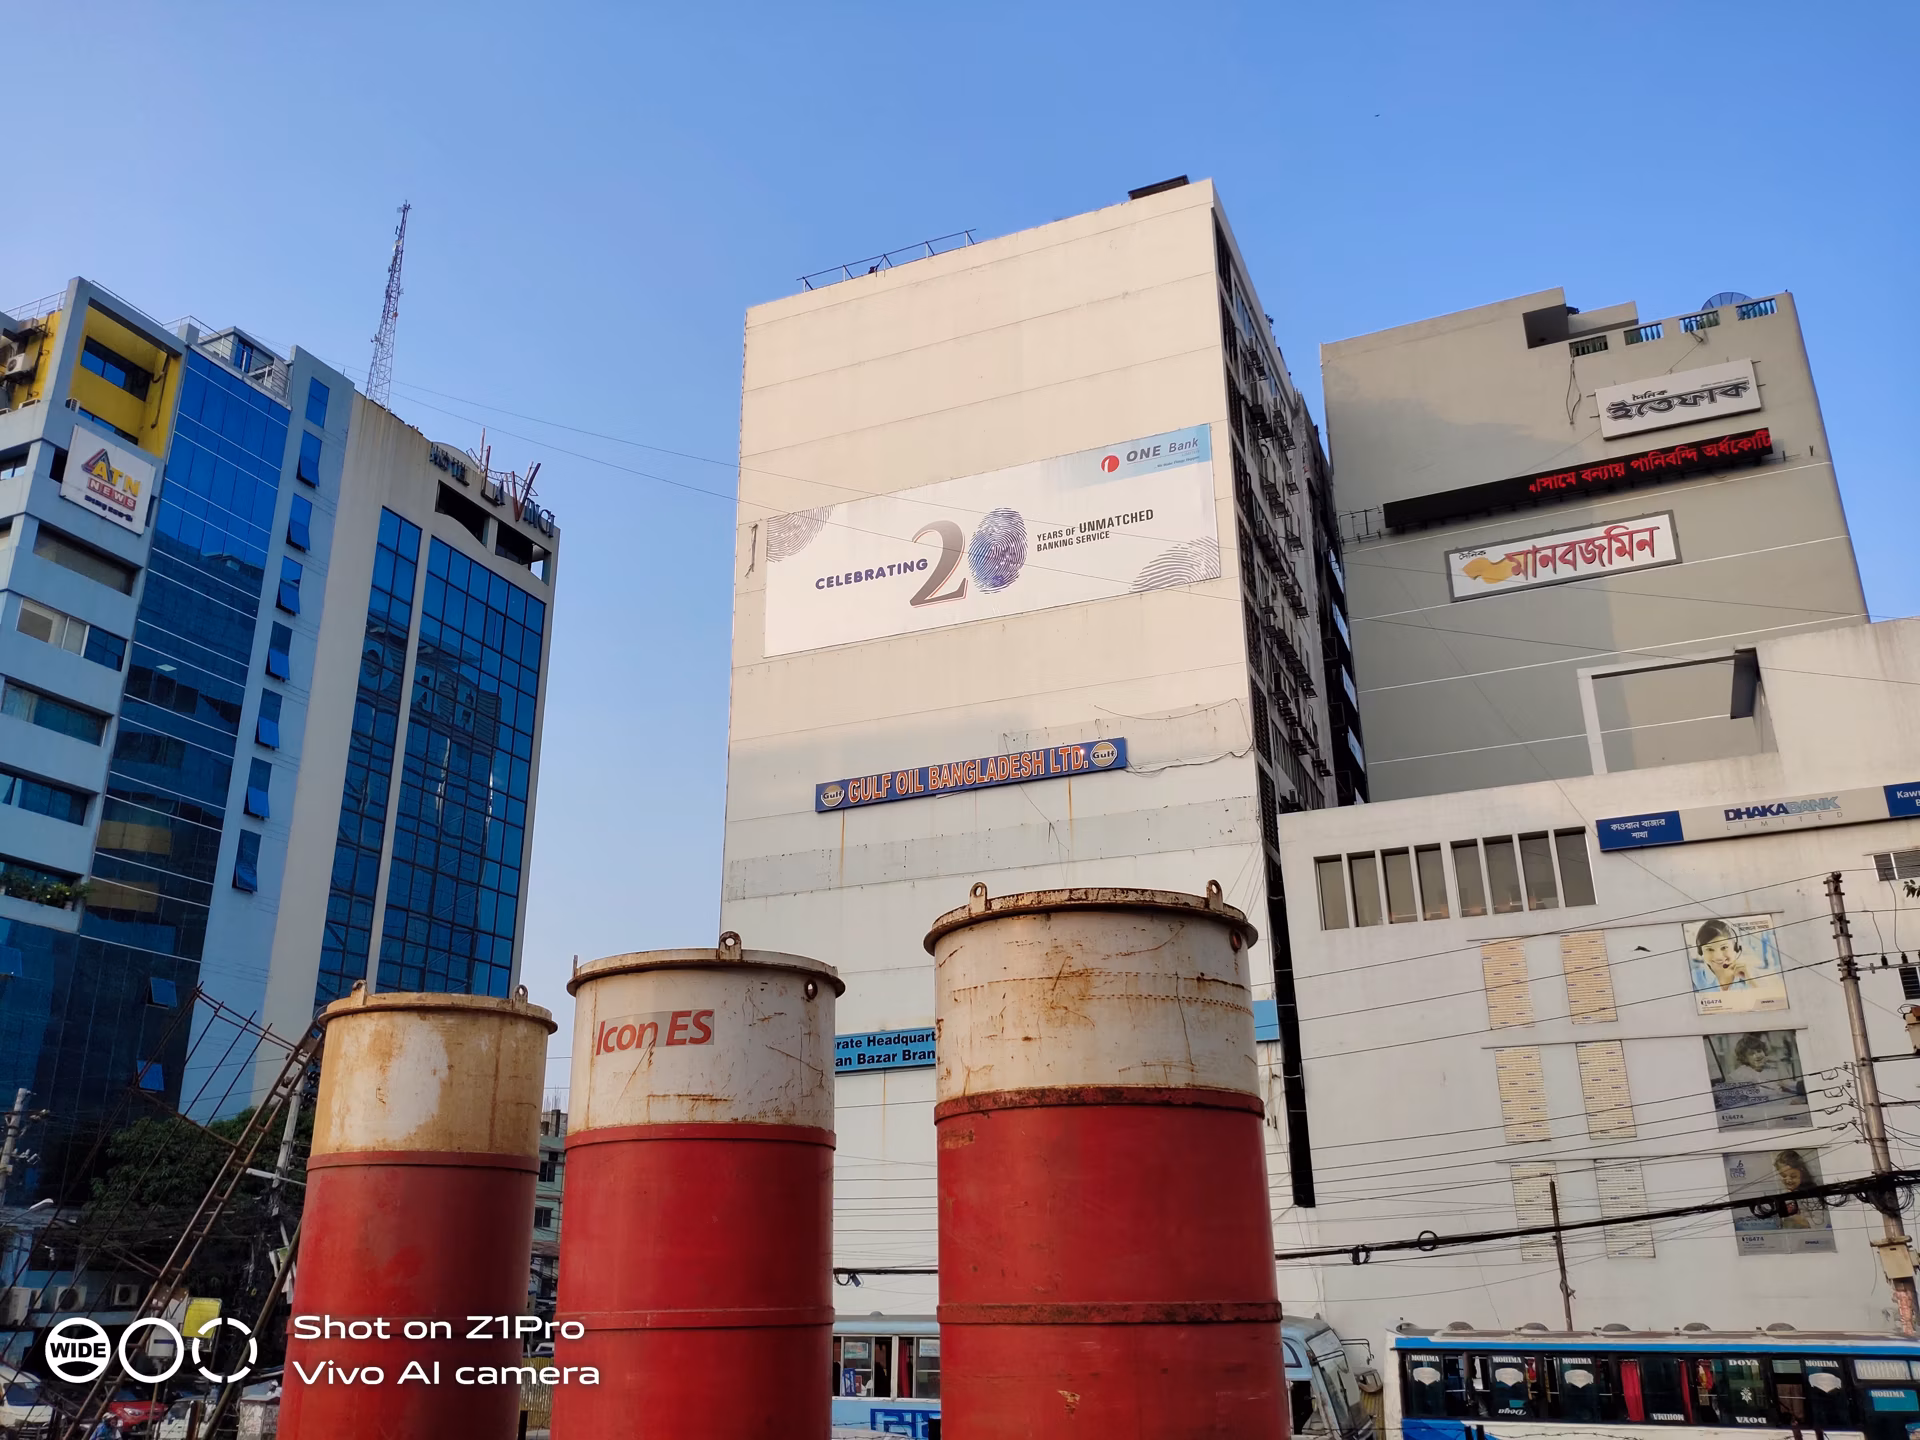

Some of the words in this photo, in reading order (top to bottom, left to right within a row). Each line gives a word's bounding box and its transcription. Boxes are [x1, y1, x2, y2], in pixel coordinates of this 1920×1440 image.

[1606, 380, 1749, 421] ইত্তেফাক
[1126, 445, 1161, 462] ONE
[1168, 437, 1199, 453] Bank
[90, 480, 134, 508] NEWS
[91, 461, 141, 497] ATN
[1037, 529, 1063, 541] YEARS
[1065, 527, 1076, 537] OF
[1079, 509, 1154, 533] UNMATCHED
[1036, 538, 1074, 552] BANKING
[1076, 530, 1110, 545] SERVICE
[1504, 525, 1660, 581] মানবজমিন
[815, 558, 928, 590] CELEBRATING
[821, 789, 844, 800] Gulf
[848, 774, 892, 804] GULF
[895, 768, 924, 796] OIL
[928, 750, 1045, 790] BANGLADESH
[1049, 745, 1089, 774] LTD.
[1091, 748, 1116, 760] Gulf
[1727, 811, 1842, 831] LIMITED
[596, 1020, 659, 1056] Icon
[666, 1010, 714, 1046] ES
[834, 1038, 863, 1050] rate
[857, 1053, 897, 1065] Bazar
[1728, 1359, 1760, 1367] DOYA
